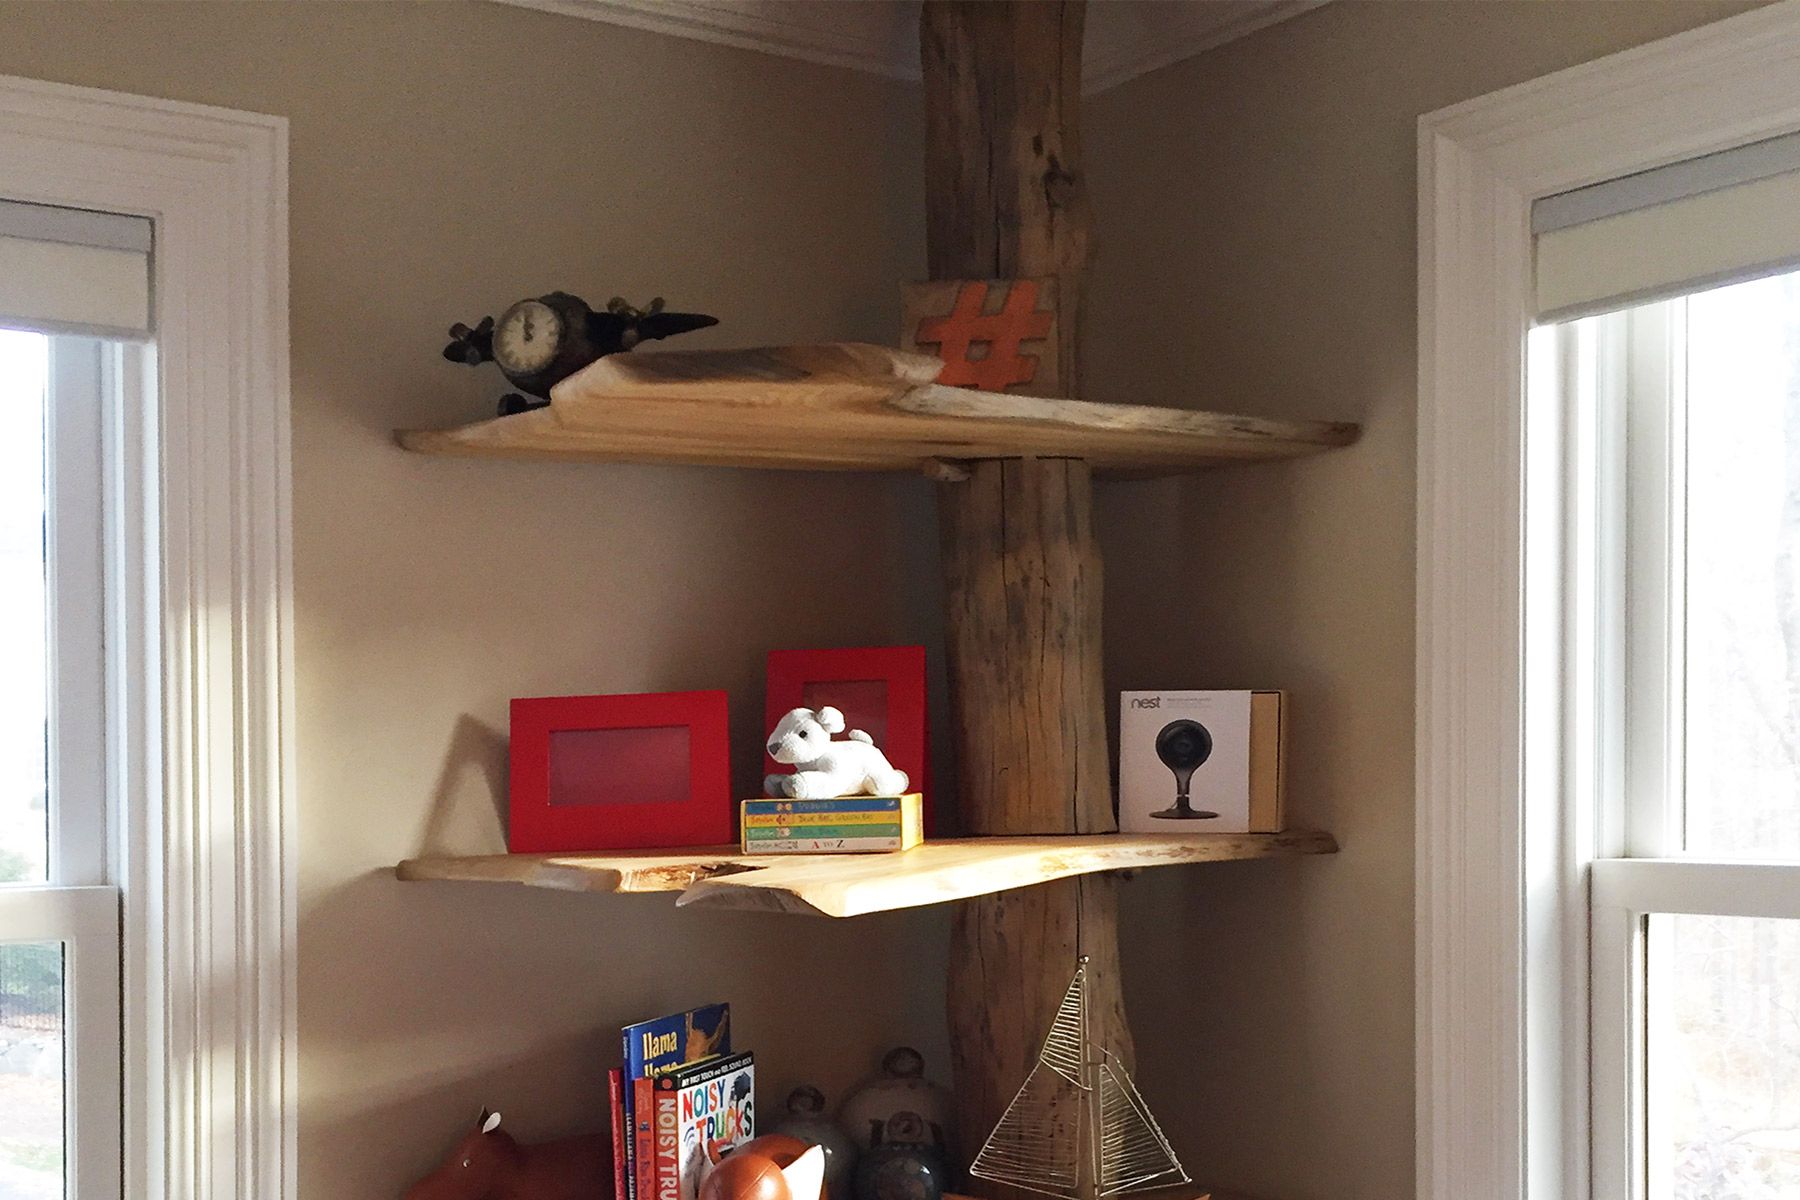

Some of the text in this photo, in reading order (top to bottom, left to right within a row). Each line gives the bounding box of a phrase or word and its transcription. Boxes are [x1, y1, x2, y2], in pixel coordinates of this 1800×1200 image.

[1131, 696, 1161, 709] nest
[812, 841, 820, 849] A
[836, 840, 845, 848] Z
[642, 1031, 678, 1060] llama
[682, 1079, 726, 1122] NOISY
[658, 1098, 677, 1160] NOISY
[695, 1100, 752, 1144] TRUCKS
